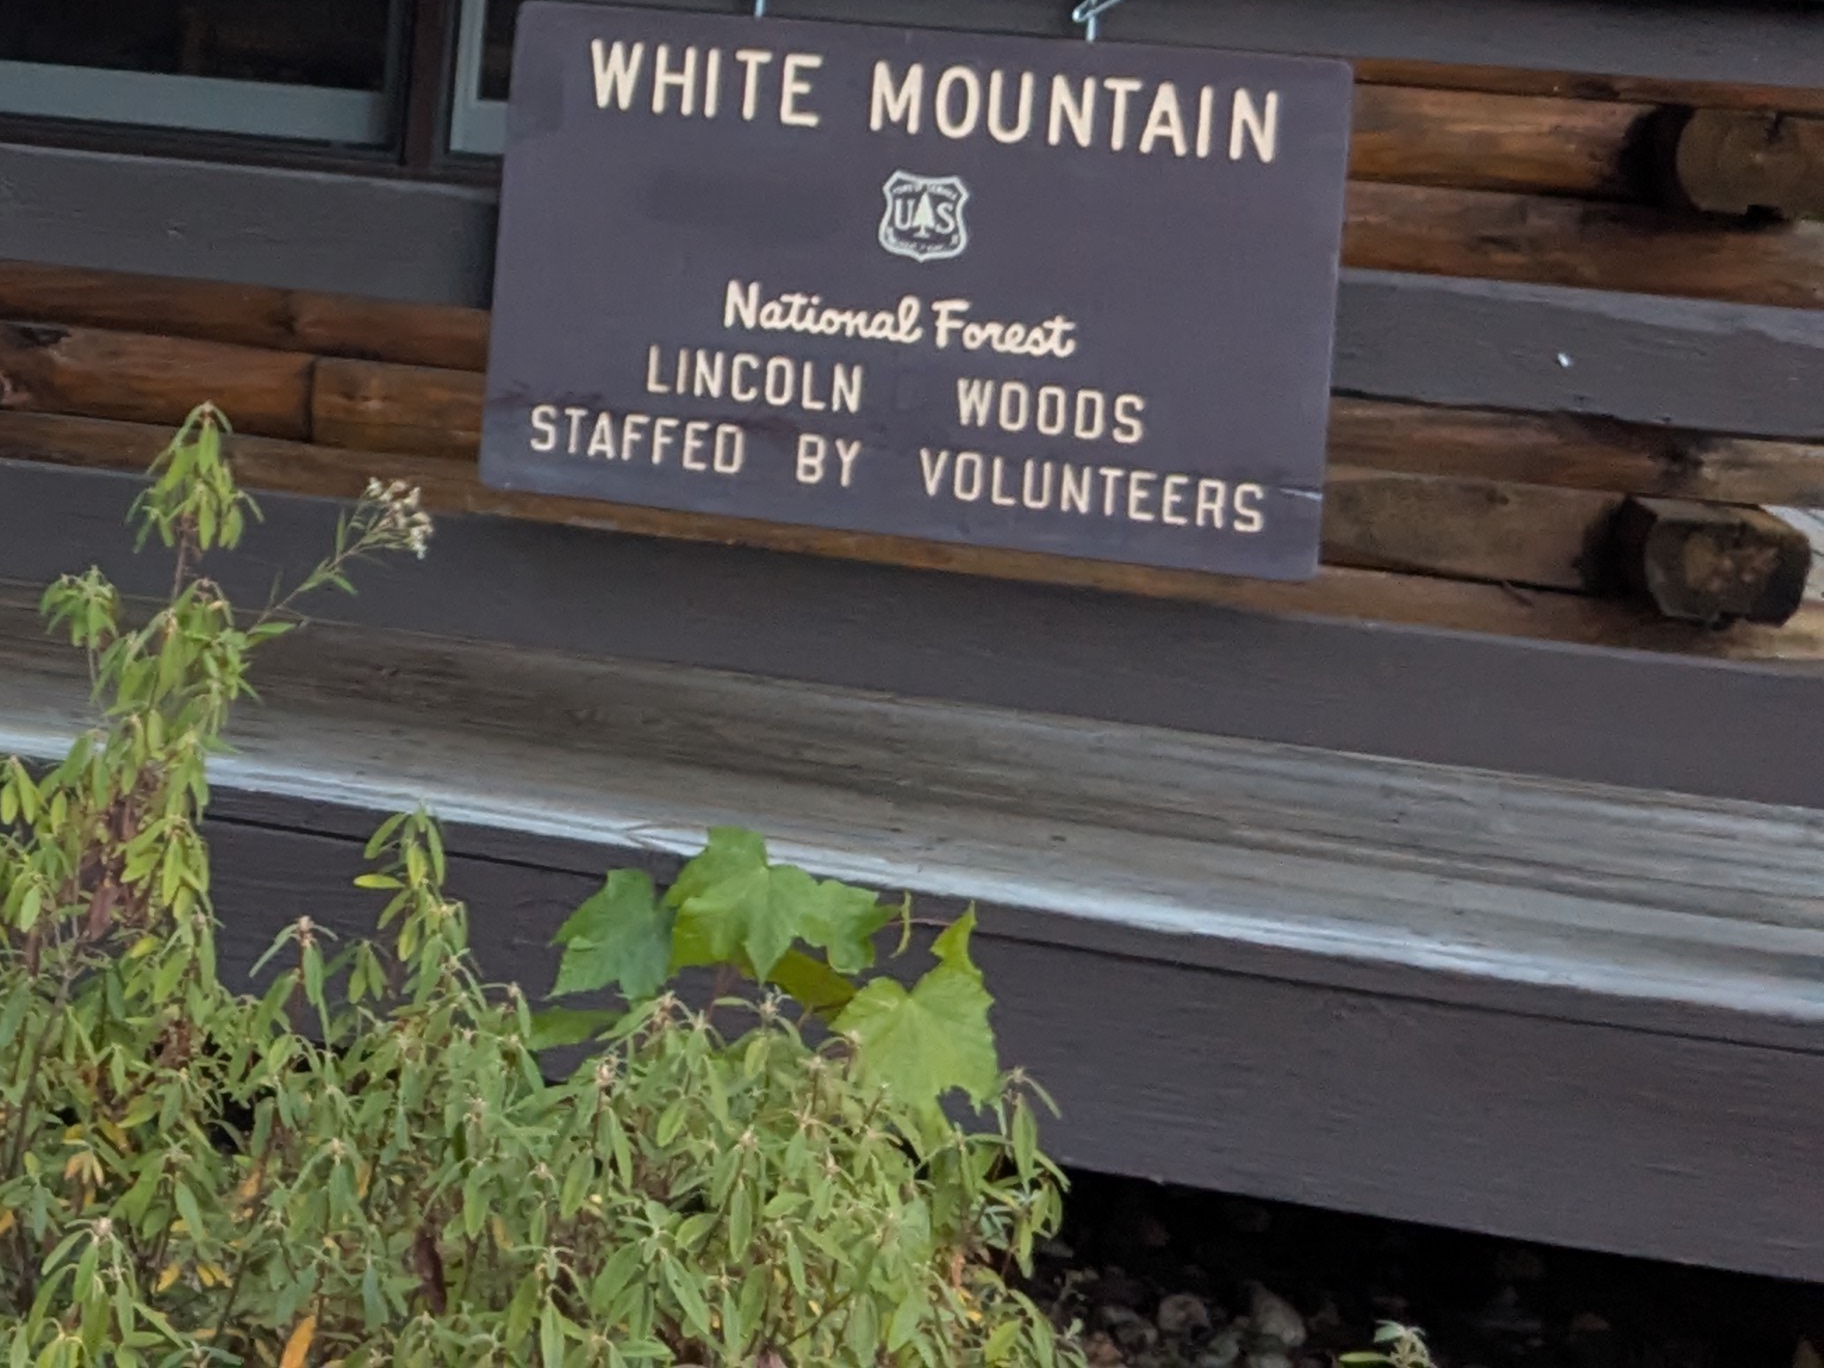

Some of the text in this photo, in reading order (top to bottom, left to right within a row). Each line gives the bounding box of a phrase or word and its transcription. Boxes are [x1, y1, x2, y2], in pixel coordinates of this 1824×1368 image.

[590, 38, 1280, 164] WHITE MOUNTAIN
[723, 279, 1077, 359] National Forest
[645, 345, 1146, 445] LINCOLN WOODS
[529, 404, 1266, 534] STAFFED BY VOLUNTEERS
